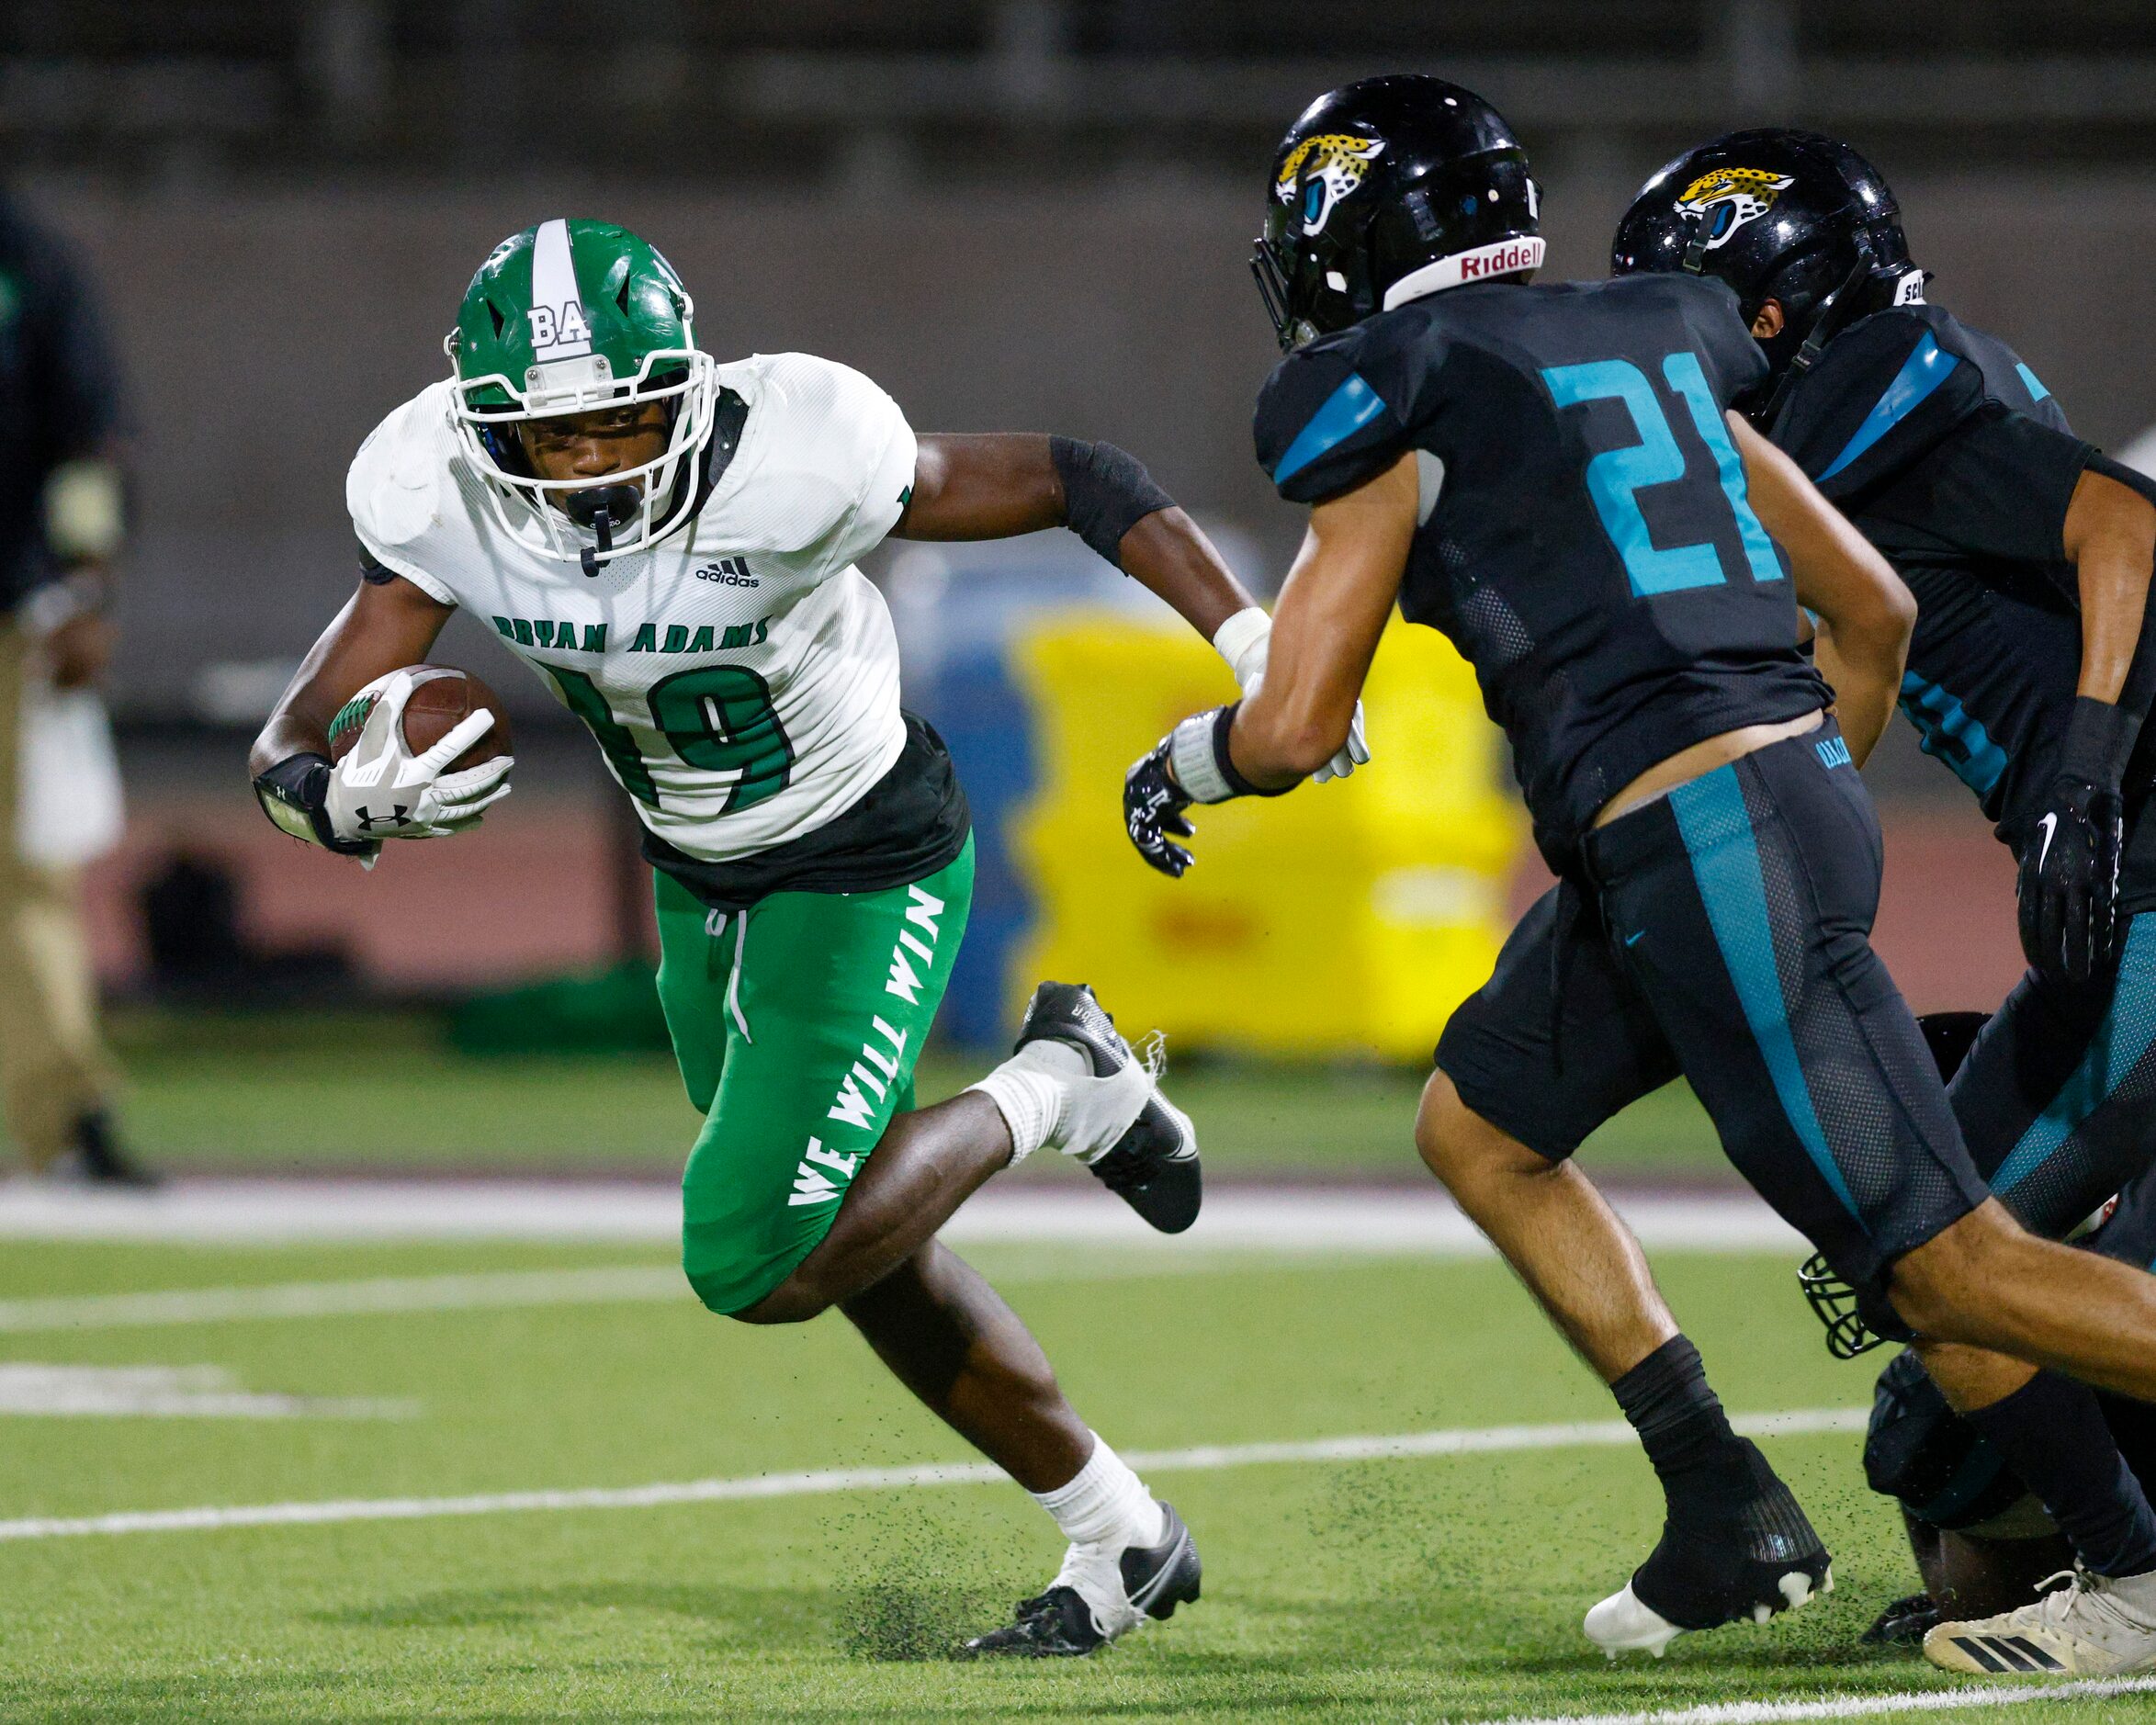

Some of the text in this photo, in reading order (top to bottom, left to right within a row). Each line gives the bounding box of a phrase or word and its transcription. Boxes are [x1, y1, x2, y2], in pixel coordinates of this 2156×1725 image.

[1461, 242, 1541, 279] Riddell
[526, 300, 593, 348] BA
[1539, 351, 1785, 599] 21
[695, 569, 760, 588] adidas
[491, 614, 773, 653] BRYAN ADAMS
[526, 654, 796, 816] 19
[787, 884, 945, 1207] WE WILL WIN
